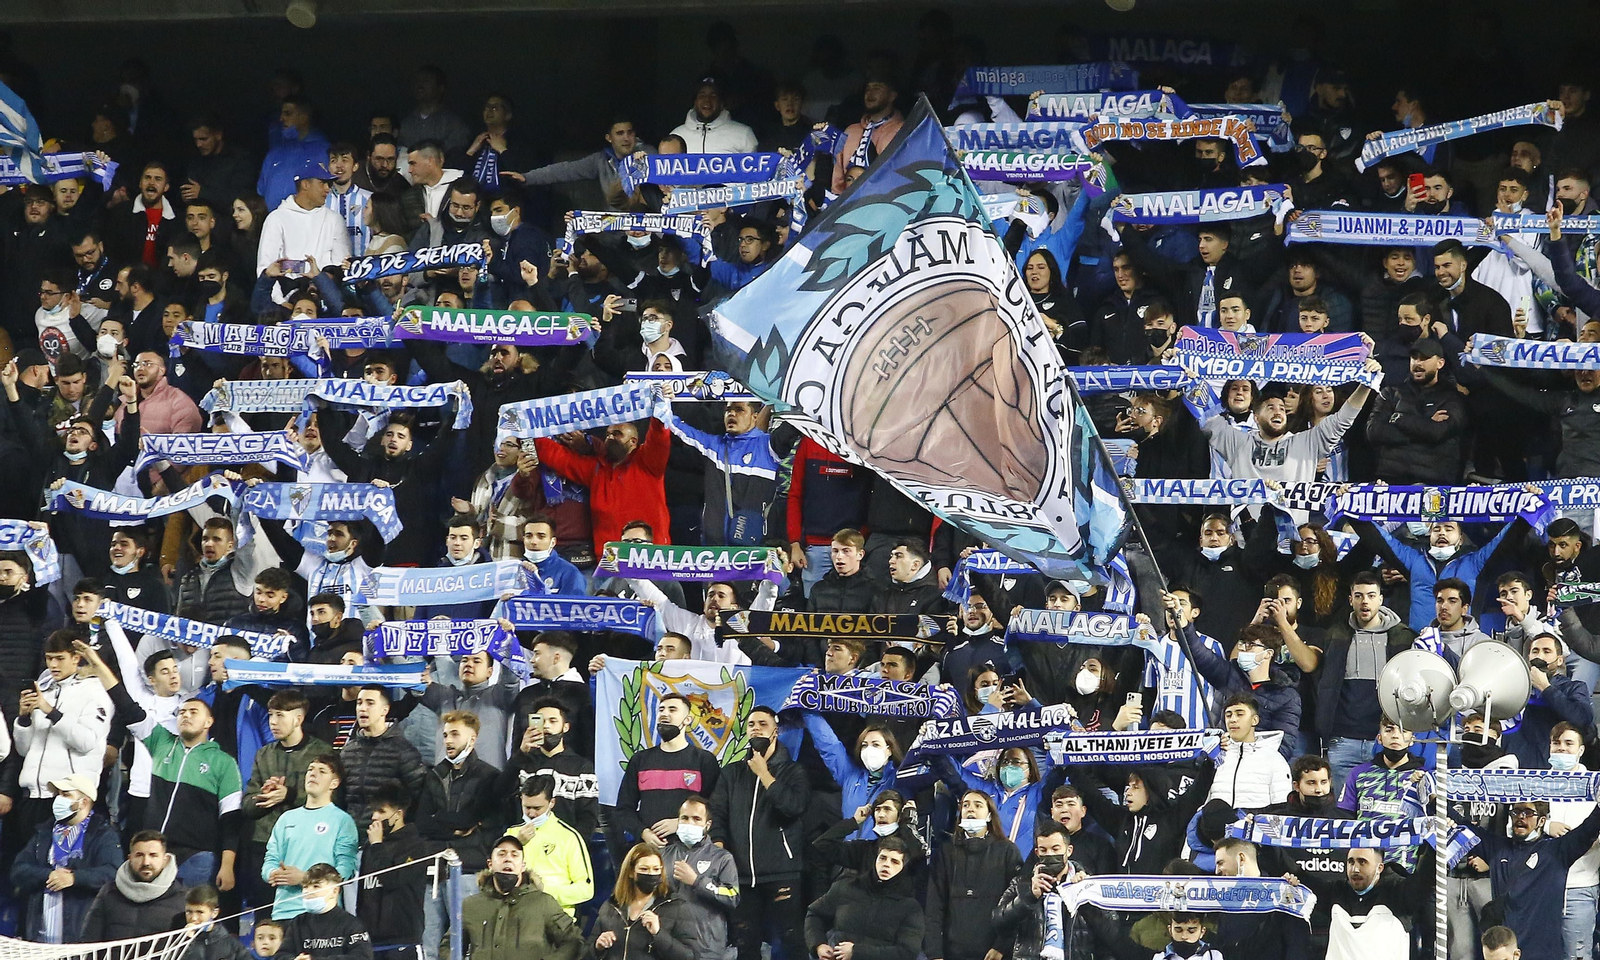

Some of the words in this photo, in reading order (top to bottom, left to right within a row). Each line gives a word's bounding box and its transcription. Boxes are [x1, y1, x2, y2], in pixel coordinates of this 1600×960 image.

[1046, 93, 1153, 118] MALAGA
[959, 129, 1072, 151] MALAGA
[1120, 123, 1143, 138] NO
[1147, 123, 1167, 137] SE
[1170, 119, 1221, 138] RINDE
[655, 156, 737, 176] MALAGA
[740, 155, 771, 173] C.F.
[738, 188, 746, 200] Y
[1142, 190, 1255, 217] MALAGA
[1335, 217, 1393, 235] JUANMI
[1399, 218, 1410, 235] &
[1415, 218, 1464, 236] PAOLA
[380, 251, 409, 273] DE
[203, 322, 309, 351] MALAGA
[1247, 358, 1265, 378] A
[1272, 362, 1373, 382] PRIMERA
[325, 379, 448, 402] MALAGA
[527, 396, 606, 430] MALAGA
[612, 388, 645, 416] C.F.
[141, 432, 290, 455] MALAGA
[188, 454, 224, 462] PUEDO
[90, 479, 205, 516] MALAGA
[1143, 479, 1267, 499] MALAGA
[1548, 485, 1564, 505] A
[733, 515, 748, 540] PUMA
[400, 574, 465, 596] MALAGA
[468, 571, 493, 590] C.F.
[161, 617, 181, 637] A
[1007, 607, 1131, 639] MALAGA
[817, 673, 931, 700] MALAGA
[997, 707, 1070, 731] MALAG
[1007, 732, 1039, 742] NACIMIENTO
[1065, 738, 1130, 753] AL-THANI
[1132, 735, 1176, 751] ¡VETE
[1177, 734, 1200, 749] YA!
[1069, 754, 1106, 763] MALAGA
[1108, 753, 1142, 762] SOMOS
[1143, 750, 1194, 761] NOSOTROS
[1285, 817, 1417, 840] MALAGA
